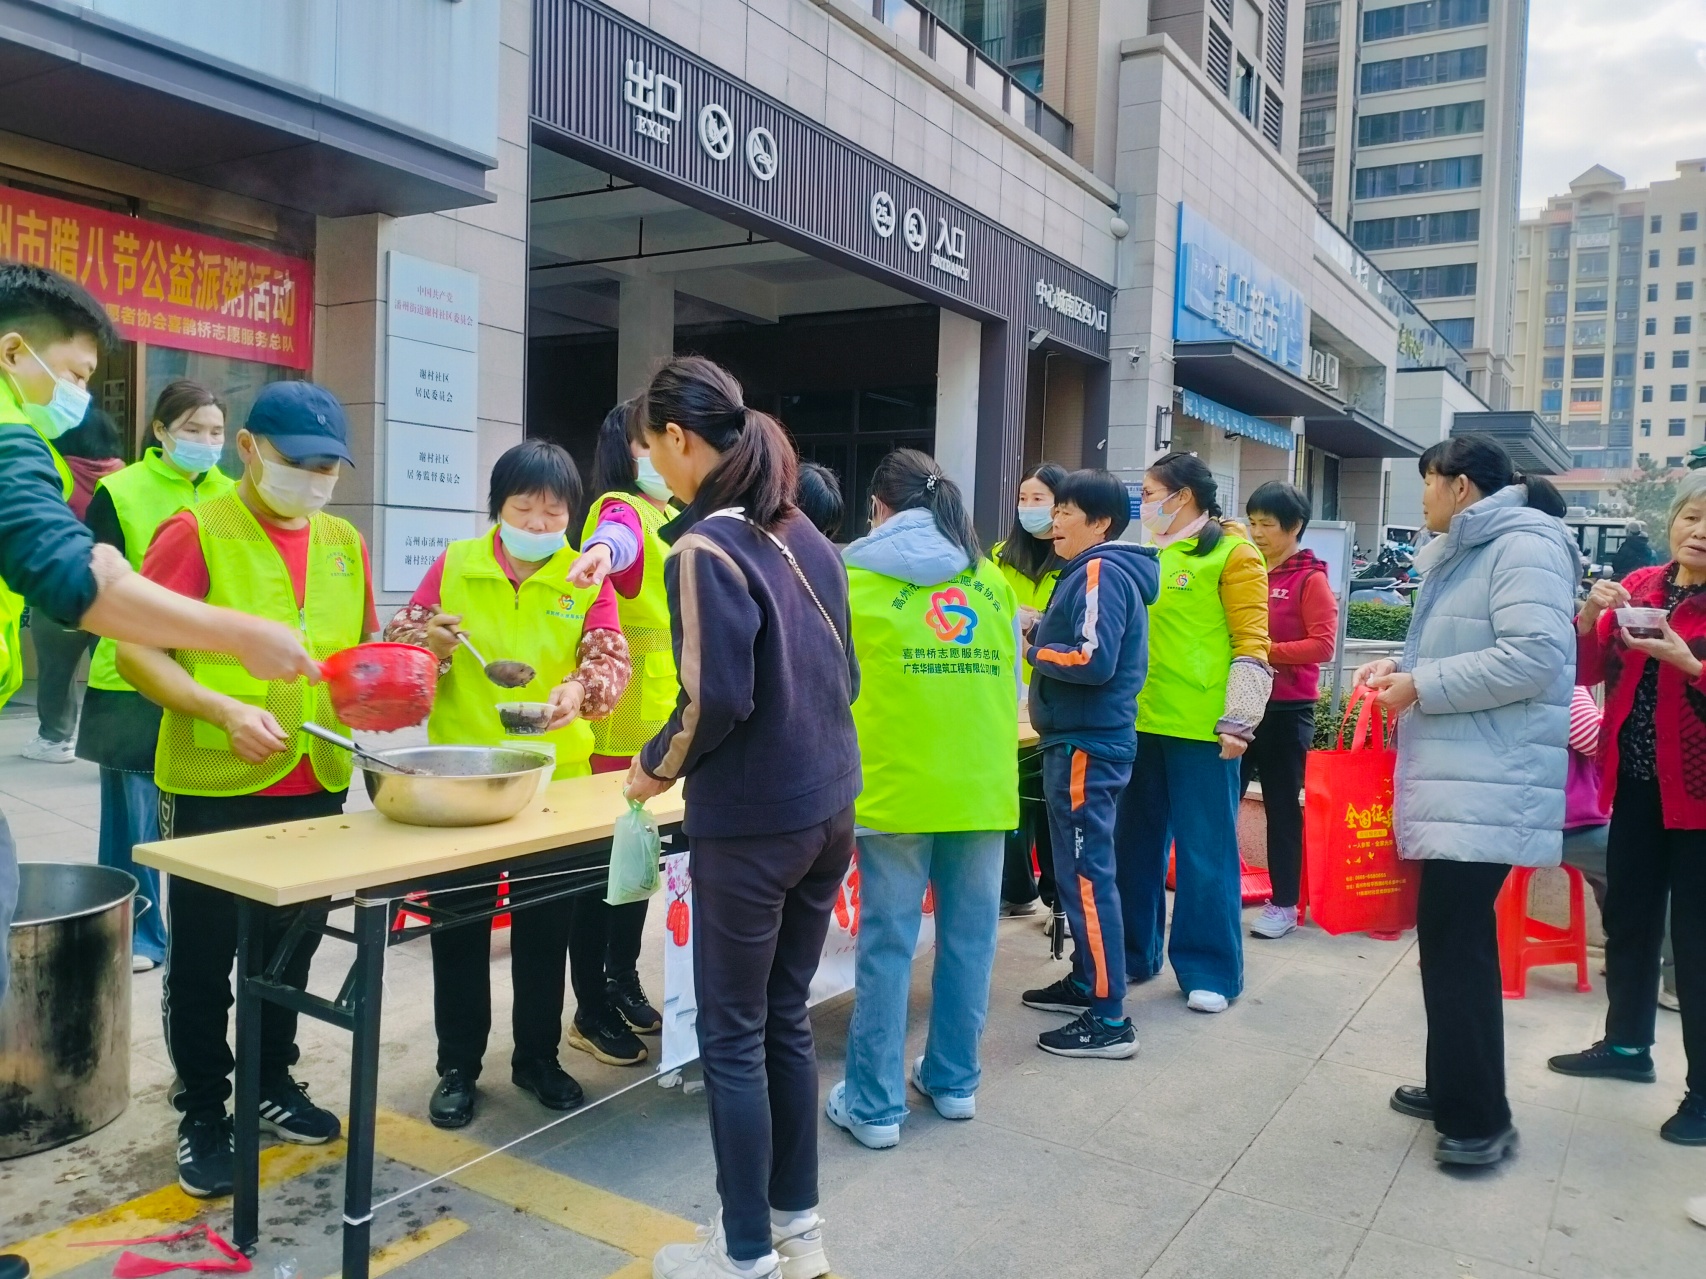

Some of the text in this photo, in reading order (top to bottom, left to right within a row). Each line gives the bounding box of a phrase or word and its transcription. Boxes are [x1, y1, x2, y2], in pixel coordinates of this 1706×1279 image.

[624, 58, 682, 122] 出口
[634, 114, 671, 145] EXIT
[935, 217, 966, 260] 入口
[929, 252, 970, 281] ENTRANCE
[417, 285, 454, 303] 中国共产党
[394, 299, 474, 327] 潘州街道谢村社区委员会
[1035, 278, 1108, 333] 中心城南区西入口
[419, 368, 450, 383] 谢村社区
[415, 386, 453, 403] 居民委员会
[418, 451, 450, 465] 谢村社区
[406, 469, 461, 485] 居务监督委员会
[405, 535, 457, 547] 高州市潘州街
[404, 554, 439, 566] 谢村经济
[902, 647, 1001, 661] 喜鹊桥志愿服务总队
